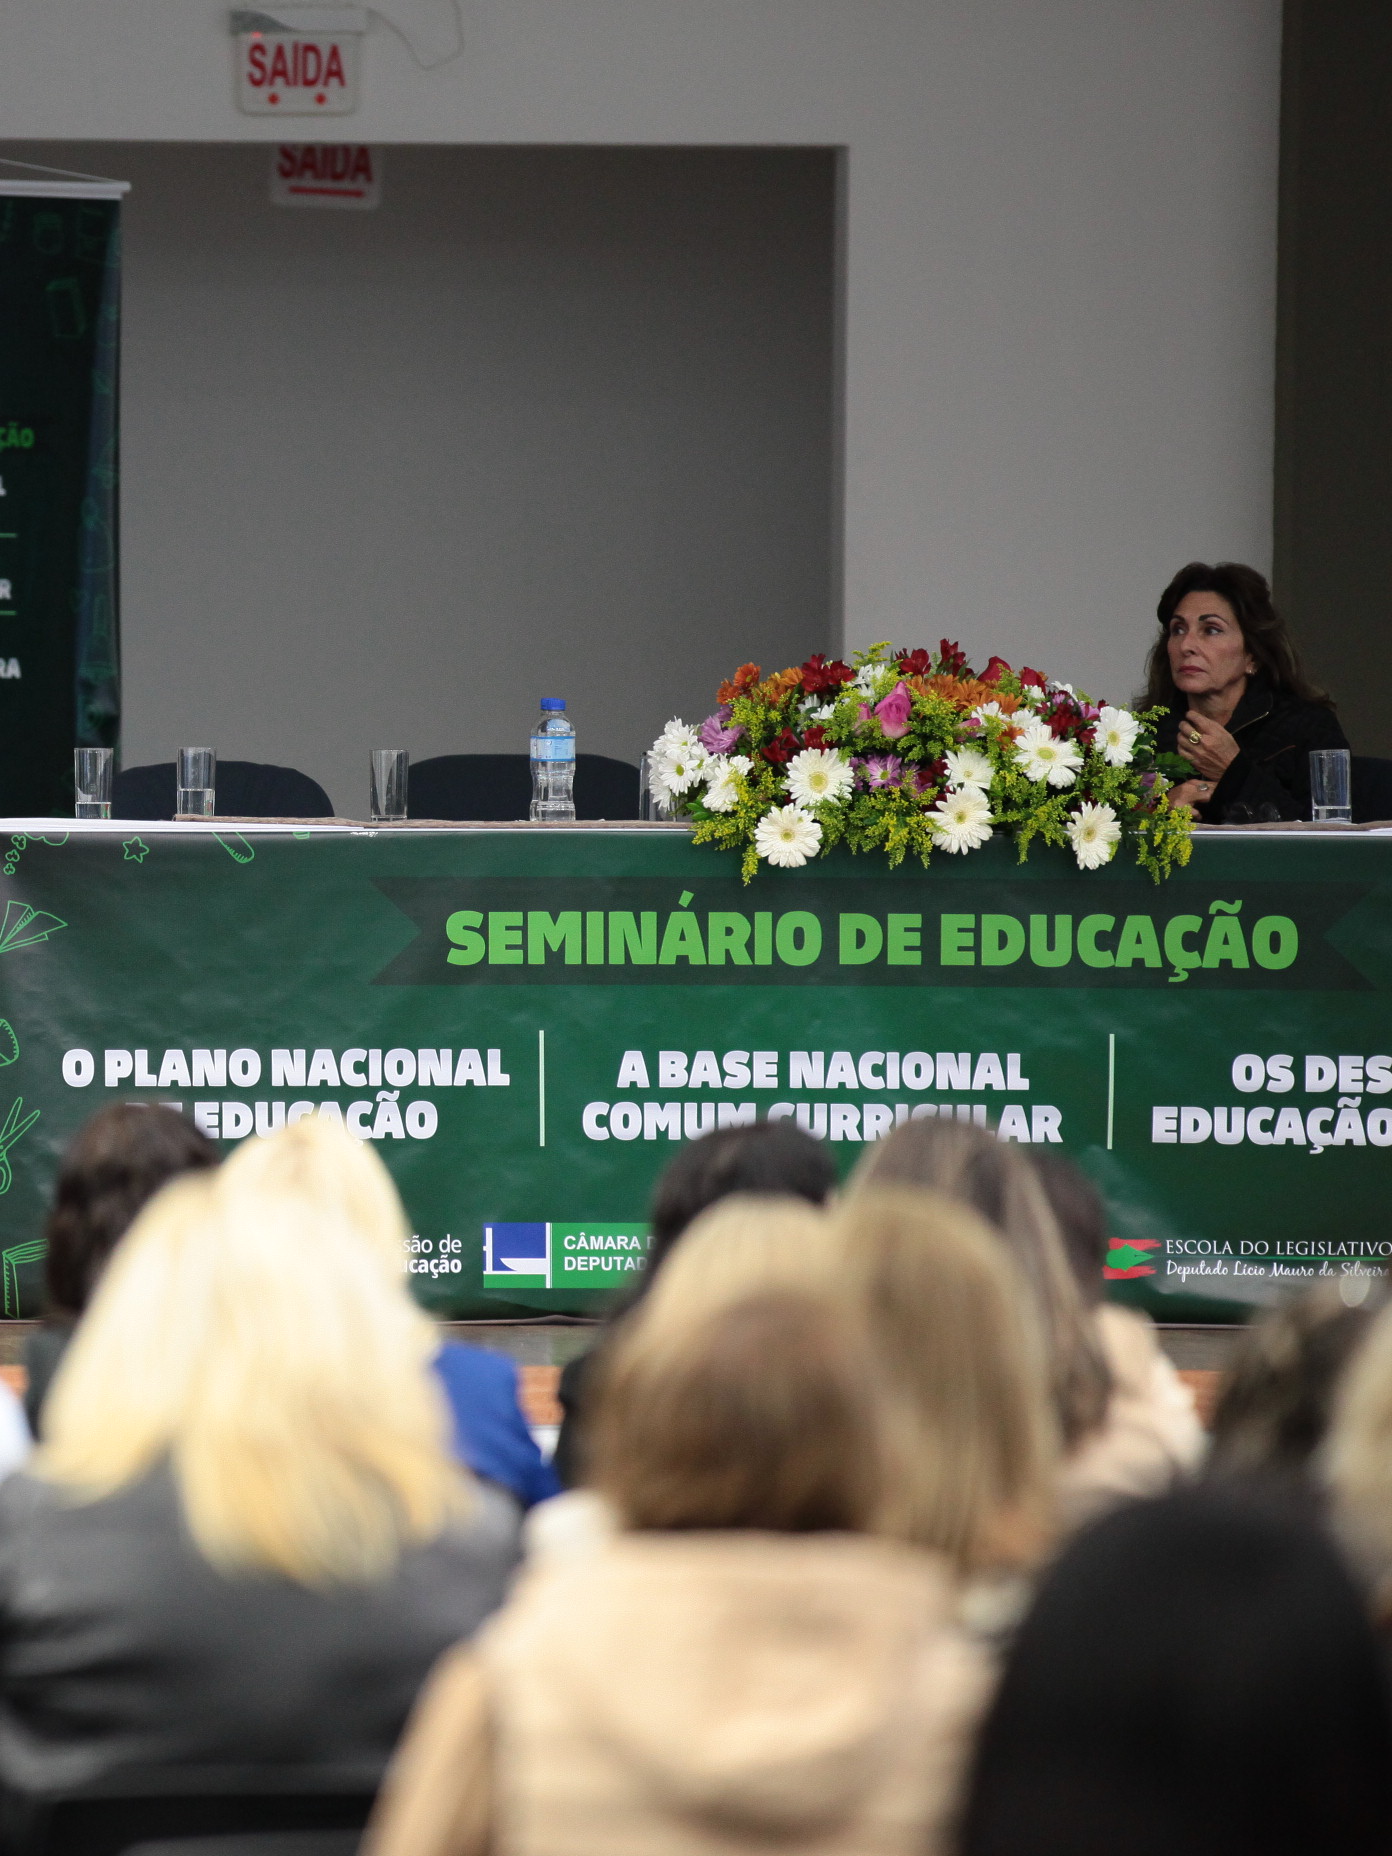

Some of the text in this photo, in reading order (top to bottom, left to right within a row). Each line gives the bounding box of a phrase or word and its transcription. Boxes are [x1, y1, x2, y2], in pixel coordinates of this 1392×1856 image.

[444, 889, 1299, 983] SEMINÁRIO DE EDUCAÇÃO
[62, 1048, 511, 1087] O PLANO NACIONAL
[616, 1050, 1030, 1091] A BASE NACIONAL
[1231, 1053, 1392, 1094] OS DES
[582, 1101, 757, 1141] COMUM
[1151, 1096, 1392, 1155] EDUCAÇÃO
[438, 1233, 462, 1254] de
[563, 1232, 642, 1250] CÂMARA
[1166, 1239, 1392, 1256] ESCOLA DO LEGISLATIVO
[1166, 1259, 1228, 1283] Deputado
[1233, 1260, 1265, 1277] Lício
[1269, 1262, 1315, 1278] Mauro
[1318, 1260, 1337, 1277] da
